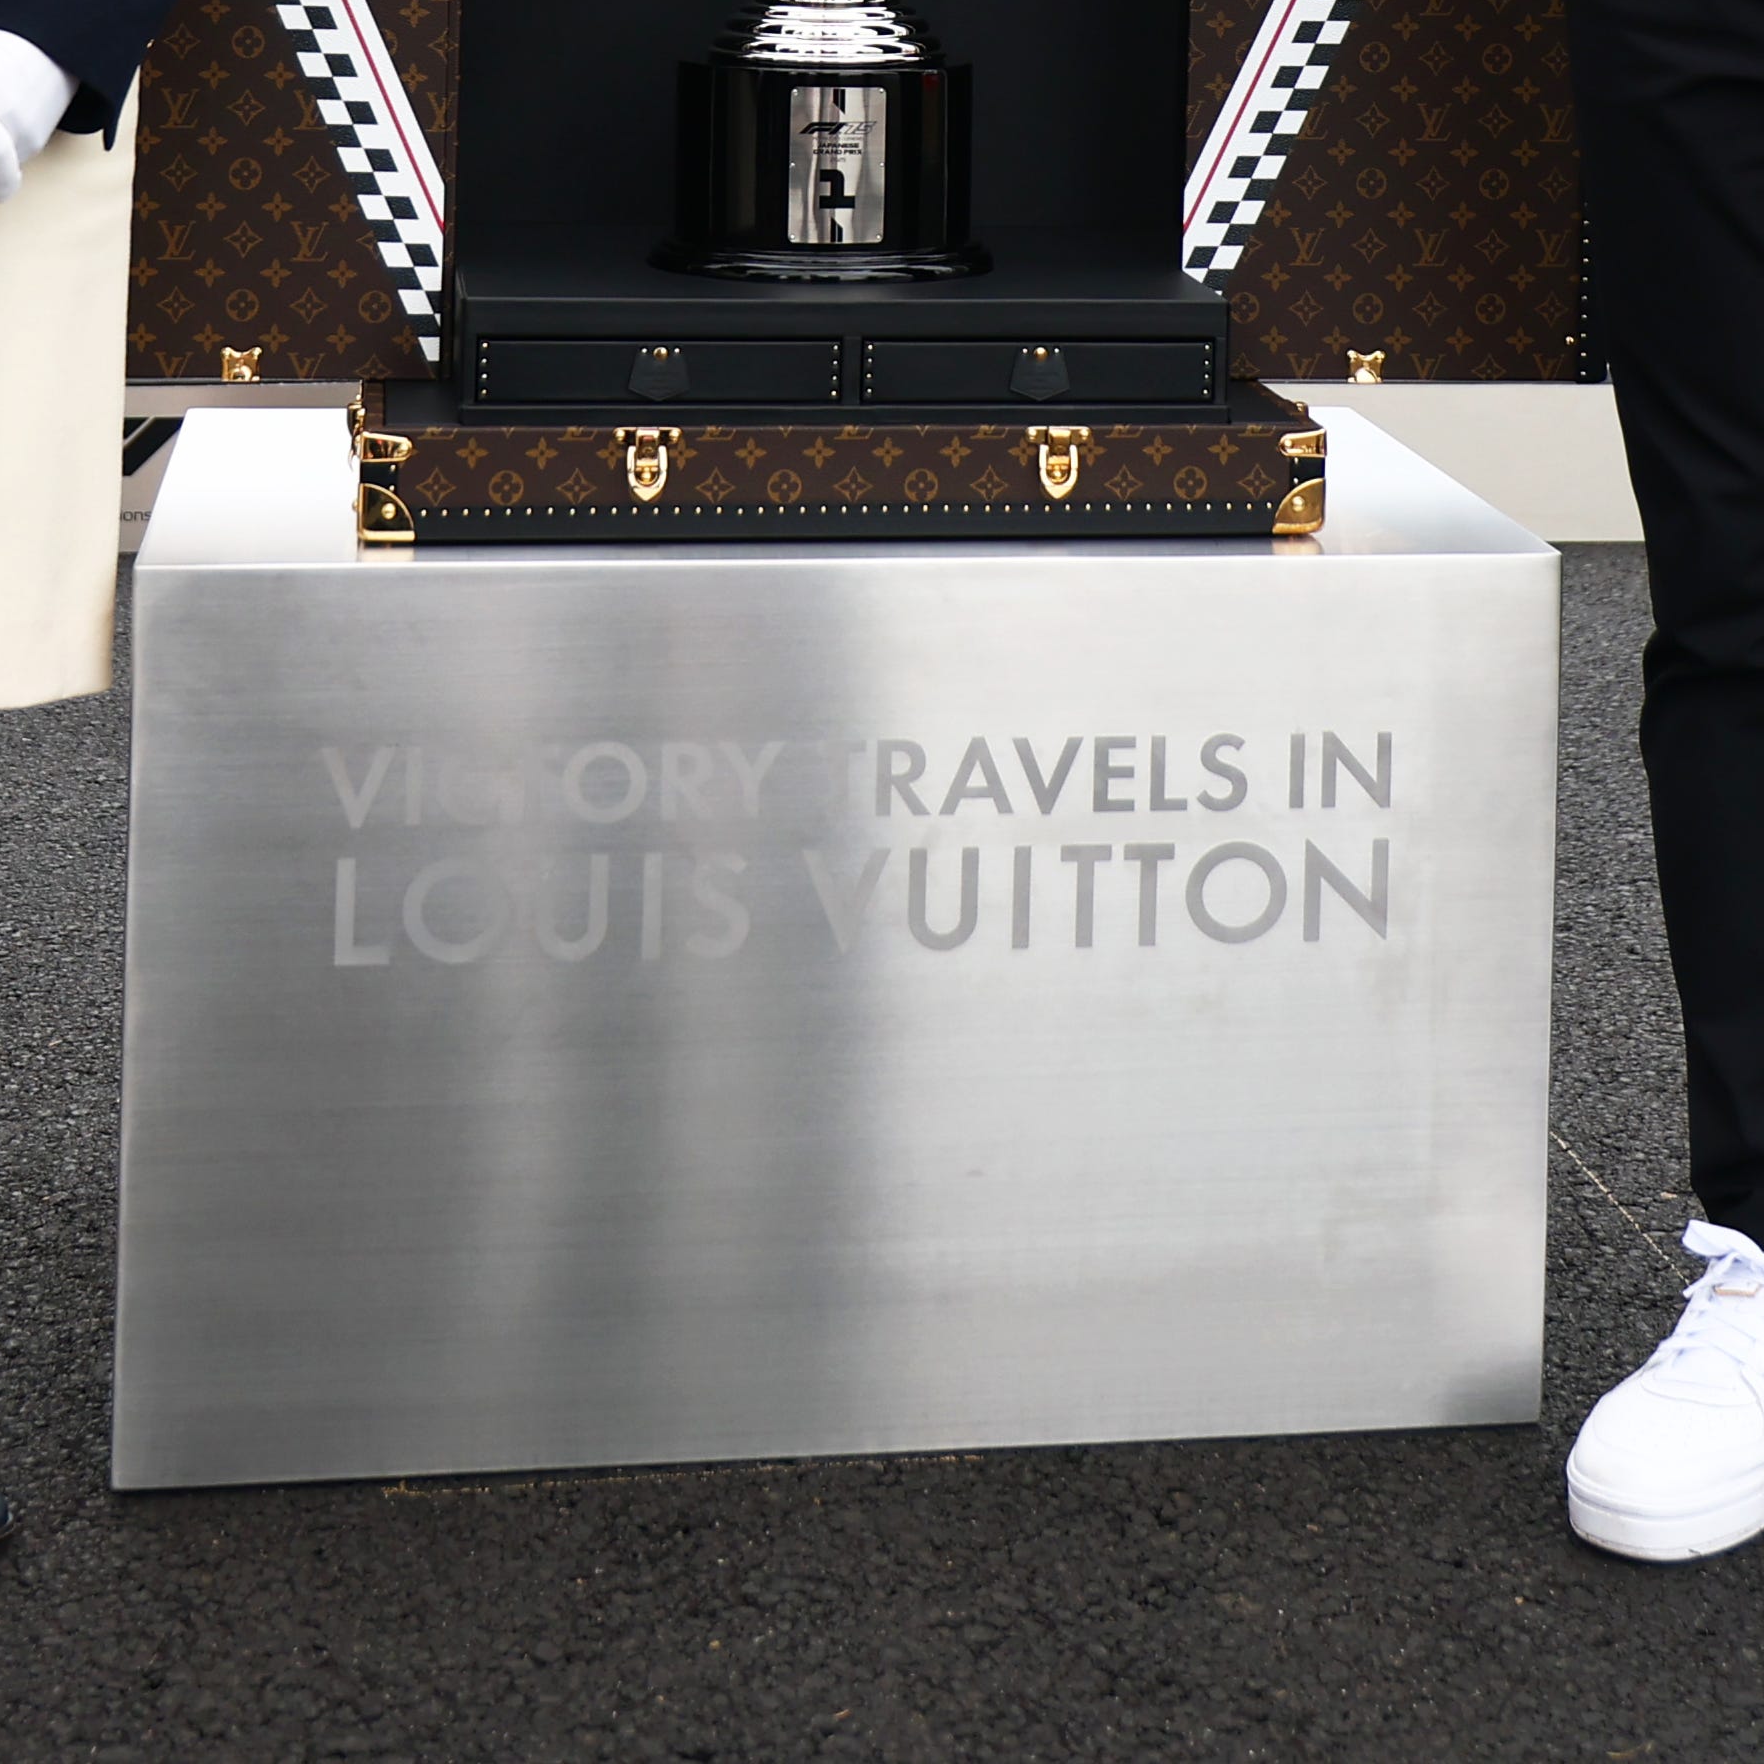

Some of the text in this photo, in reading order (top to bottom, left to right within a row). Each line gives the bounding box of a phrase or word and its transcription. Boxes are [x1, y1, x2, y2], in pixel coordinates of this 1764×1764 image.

[814, 733, 1248, 820] TRAVELS
[1289, 730, 1392, 809] IN
[334, 837, 1389, 966] LOUIS VUITTON
